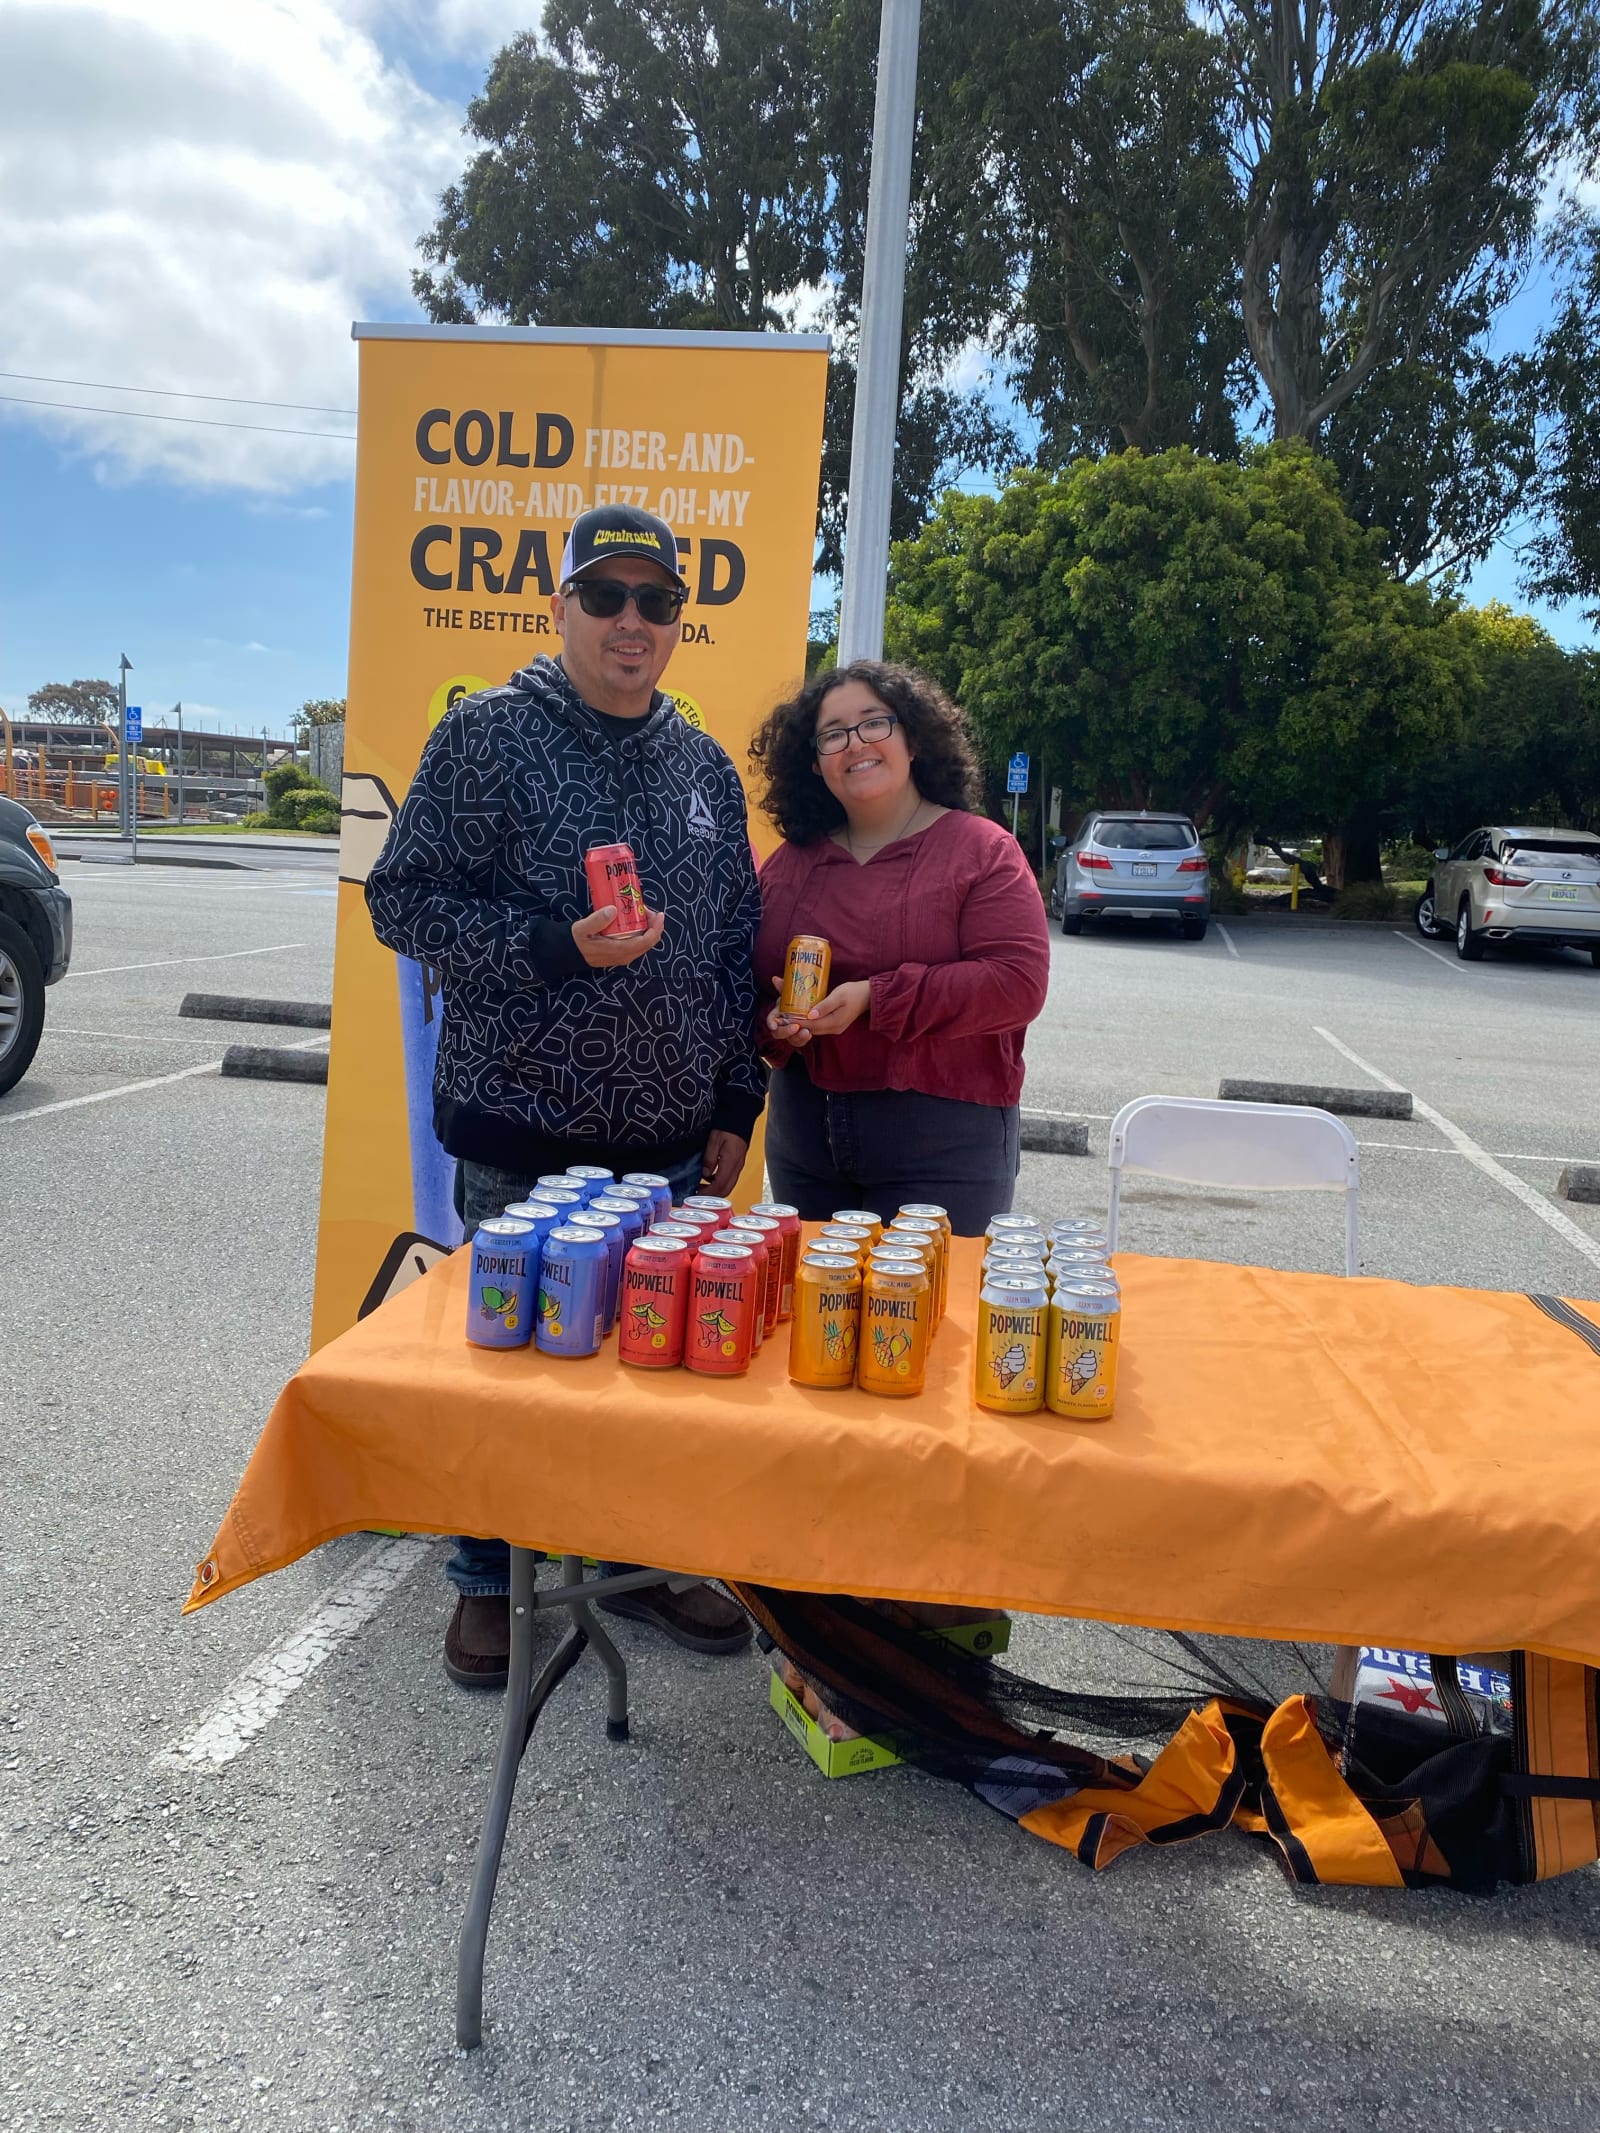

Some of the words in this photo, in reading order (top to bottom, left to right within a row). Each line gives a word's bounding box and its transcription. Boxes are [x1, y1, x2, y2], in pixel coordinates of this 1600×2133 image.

[415, 408, 575, 469] COLD
[584, 428, 755, 474] FIBER-AND-
[410, 524, 746, 606] CRAD
[424, 607, 463, 628] THE
[469, 611, 550, 635] BETTER
[476, 1254, 527, 1278] POPWELL
[541, 1260, 571, 1287] PWELL
[626, 1270, 675, 1296] POPWELL
[694, 1278, 744, 1303] POPWELL
[867, 1296, 918, 1322] POPWELL
[989, 1313, 1041, 1337] POPWELL
[1060, 1318, 1113, 1343] POPWELL
